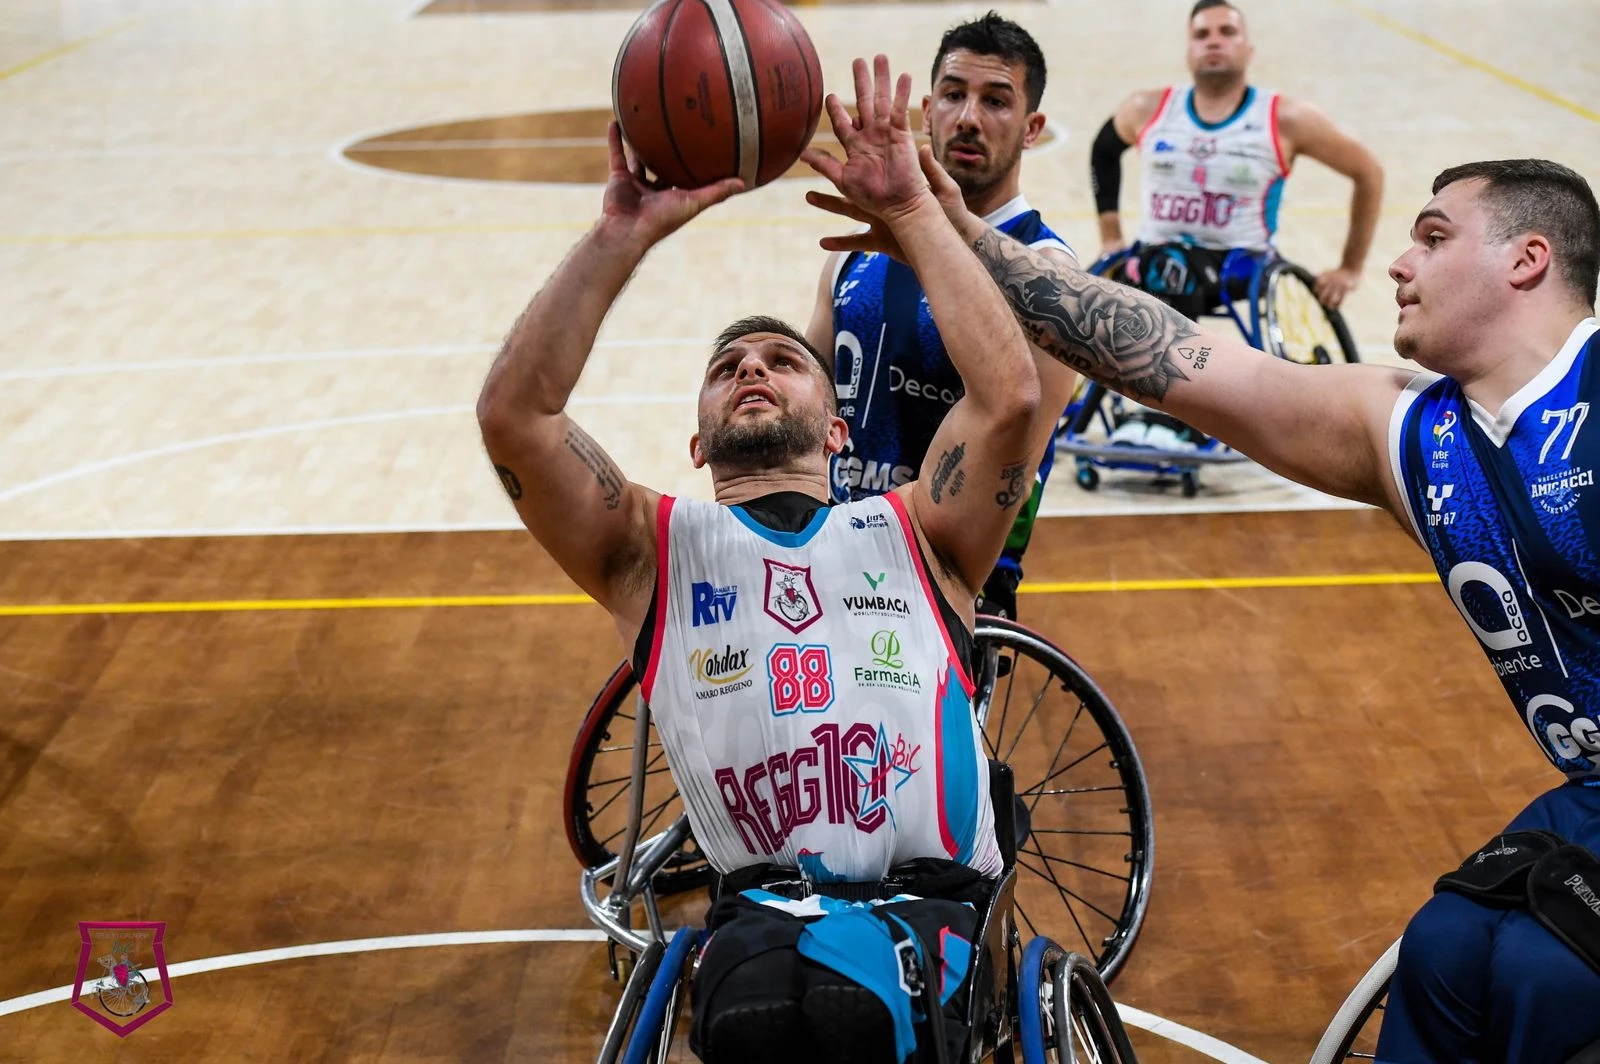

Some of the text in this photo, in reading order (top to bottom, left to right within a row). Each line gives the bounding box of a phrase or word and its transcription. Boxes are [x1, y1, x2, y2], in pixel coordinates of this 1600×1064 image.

[1193, 346, 1211, 369] 1982
[1538, 402, 1590, 464] 77
[1531, 469, 1595, 499] AMICACCI
[1426, 511, 1457, 527] TOP 87
[691, 581, 737, 628] RTV
[843, 596, 911, 615] VUMBACA
[1502, 590, 1527, 642] acea
[1491, 651, 1543, 677] biente
[696, 679, 753, 700] AMARO REGGINO
[766, 643, 835, 717] 88
